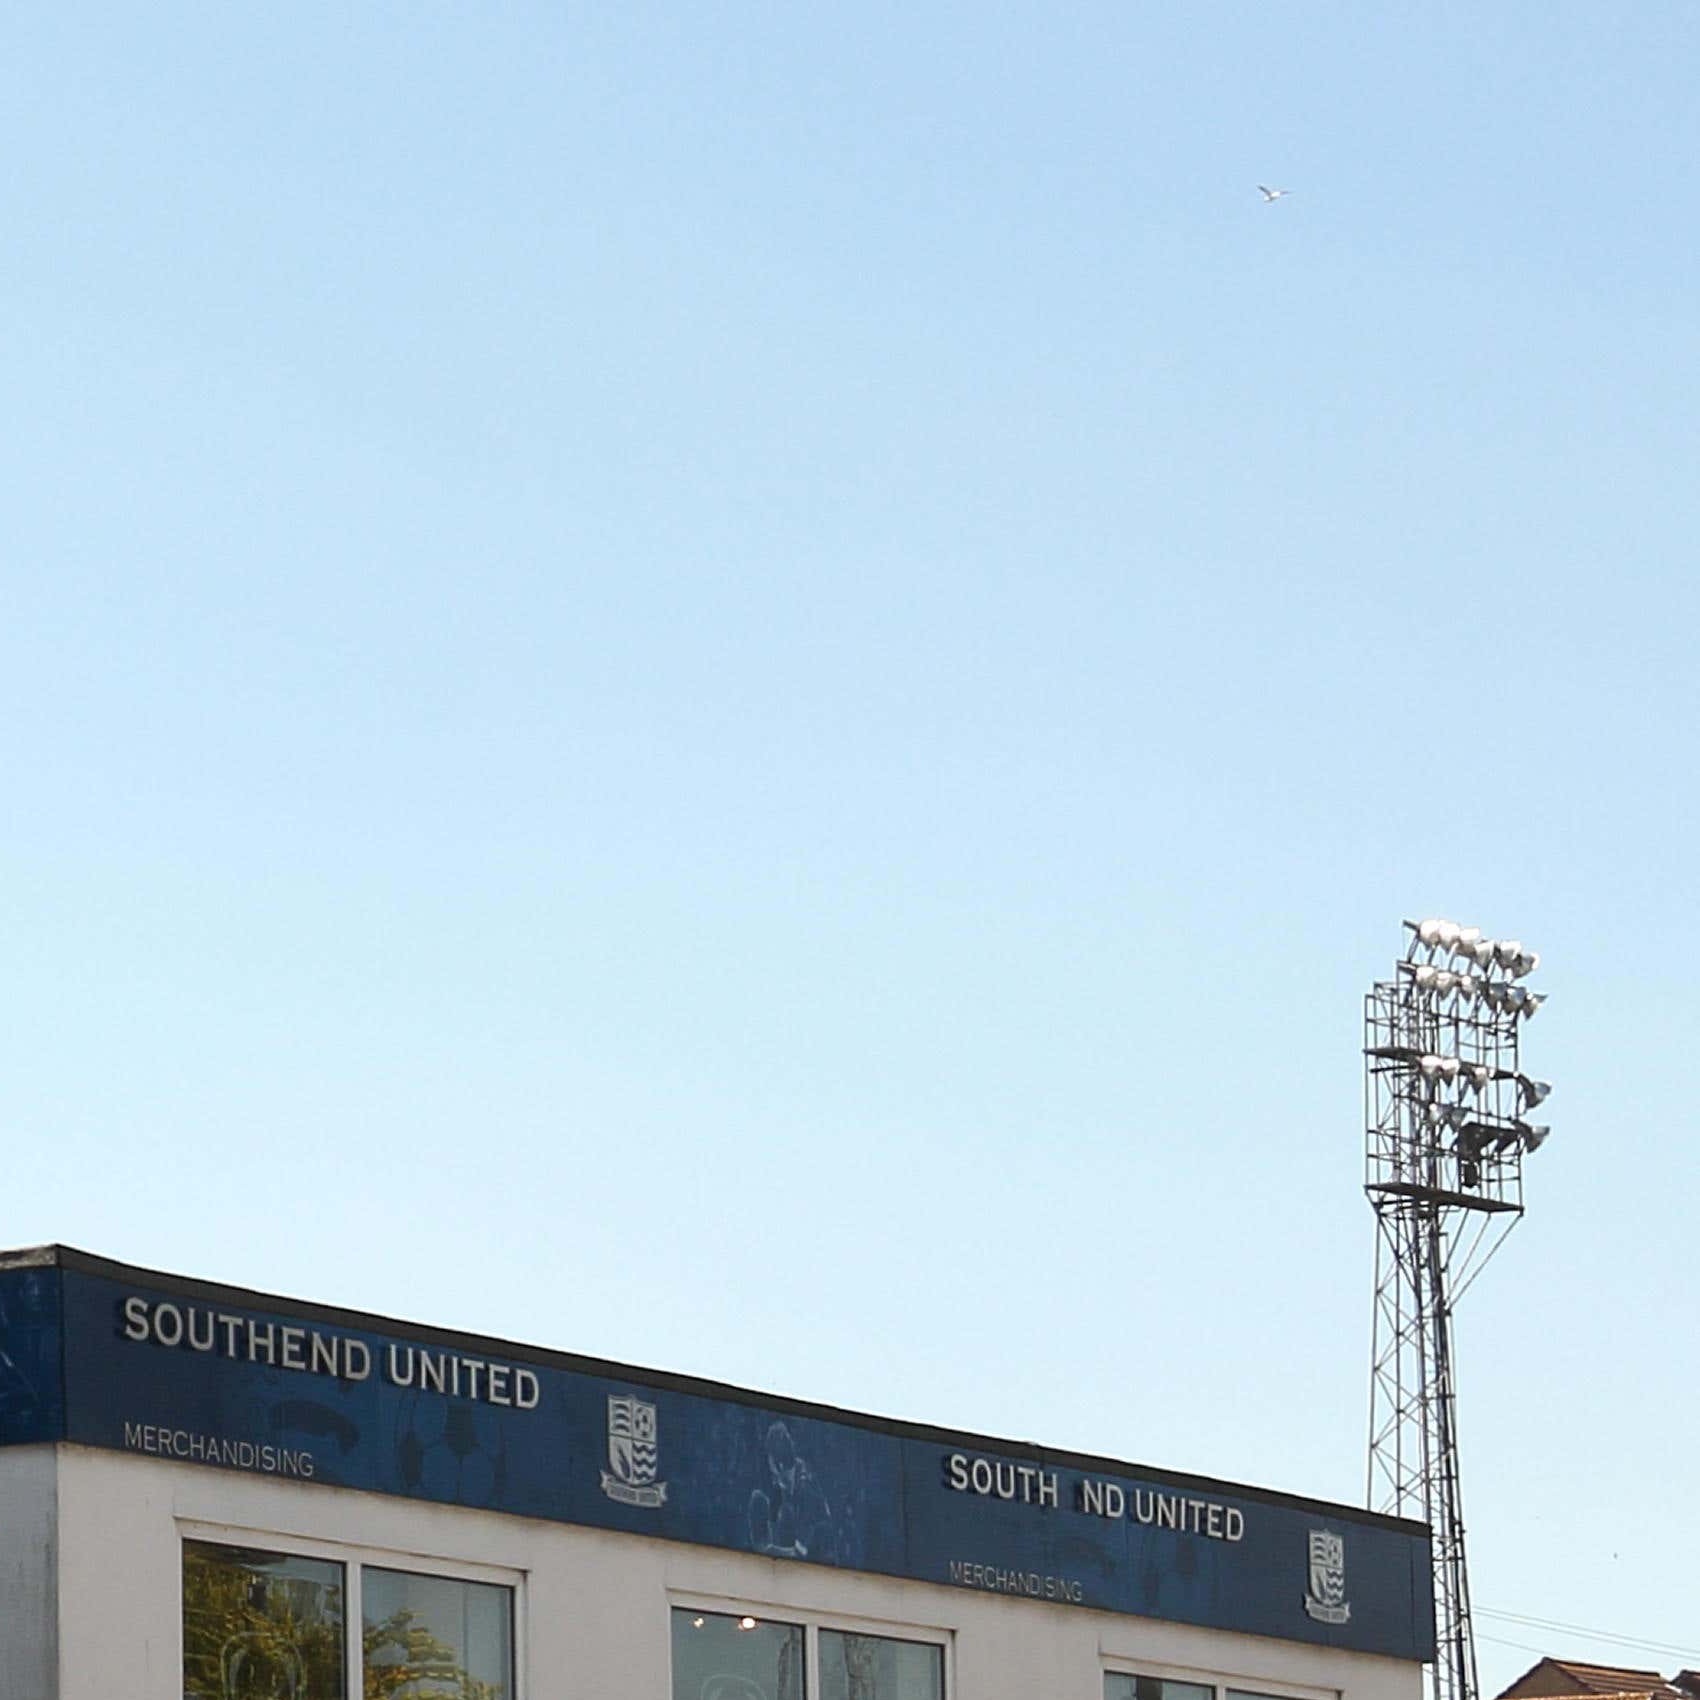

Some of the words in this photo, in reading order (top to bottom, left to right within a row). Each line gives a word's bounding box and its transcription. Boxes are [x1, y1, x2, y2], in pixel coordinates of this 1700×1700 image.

[123, 1297, 371, 1382] SOUTHEND
[389, 1343, 541, 1410] UNITED
[123, 1422, 315, 1478] MERCHANDISING
[1135, 1488, 1245, 1542] UNITED
[950, 1560, 1083, 1602] MERCHANDISING
